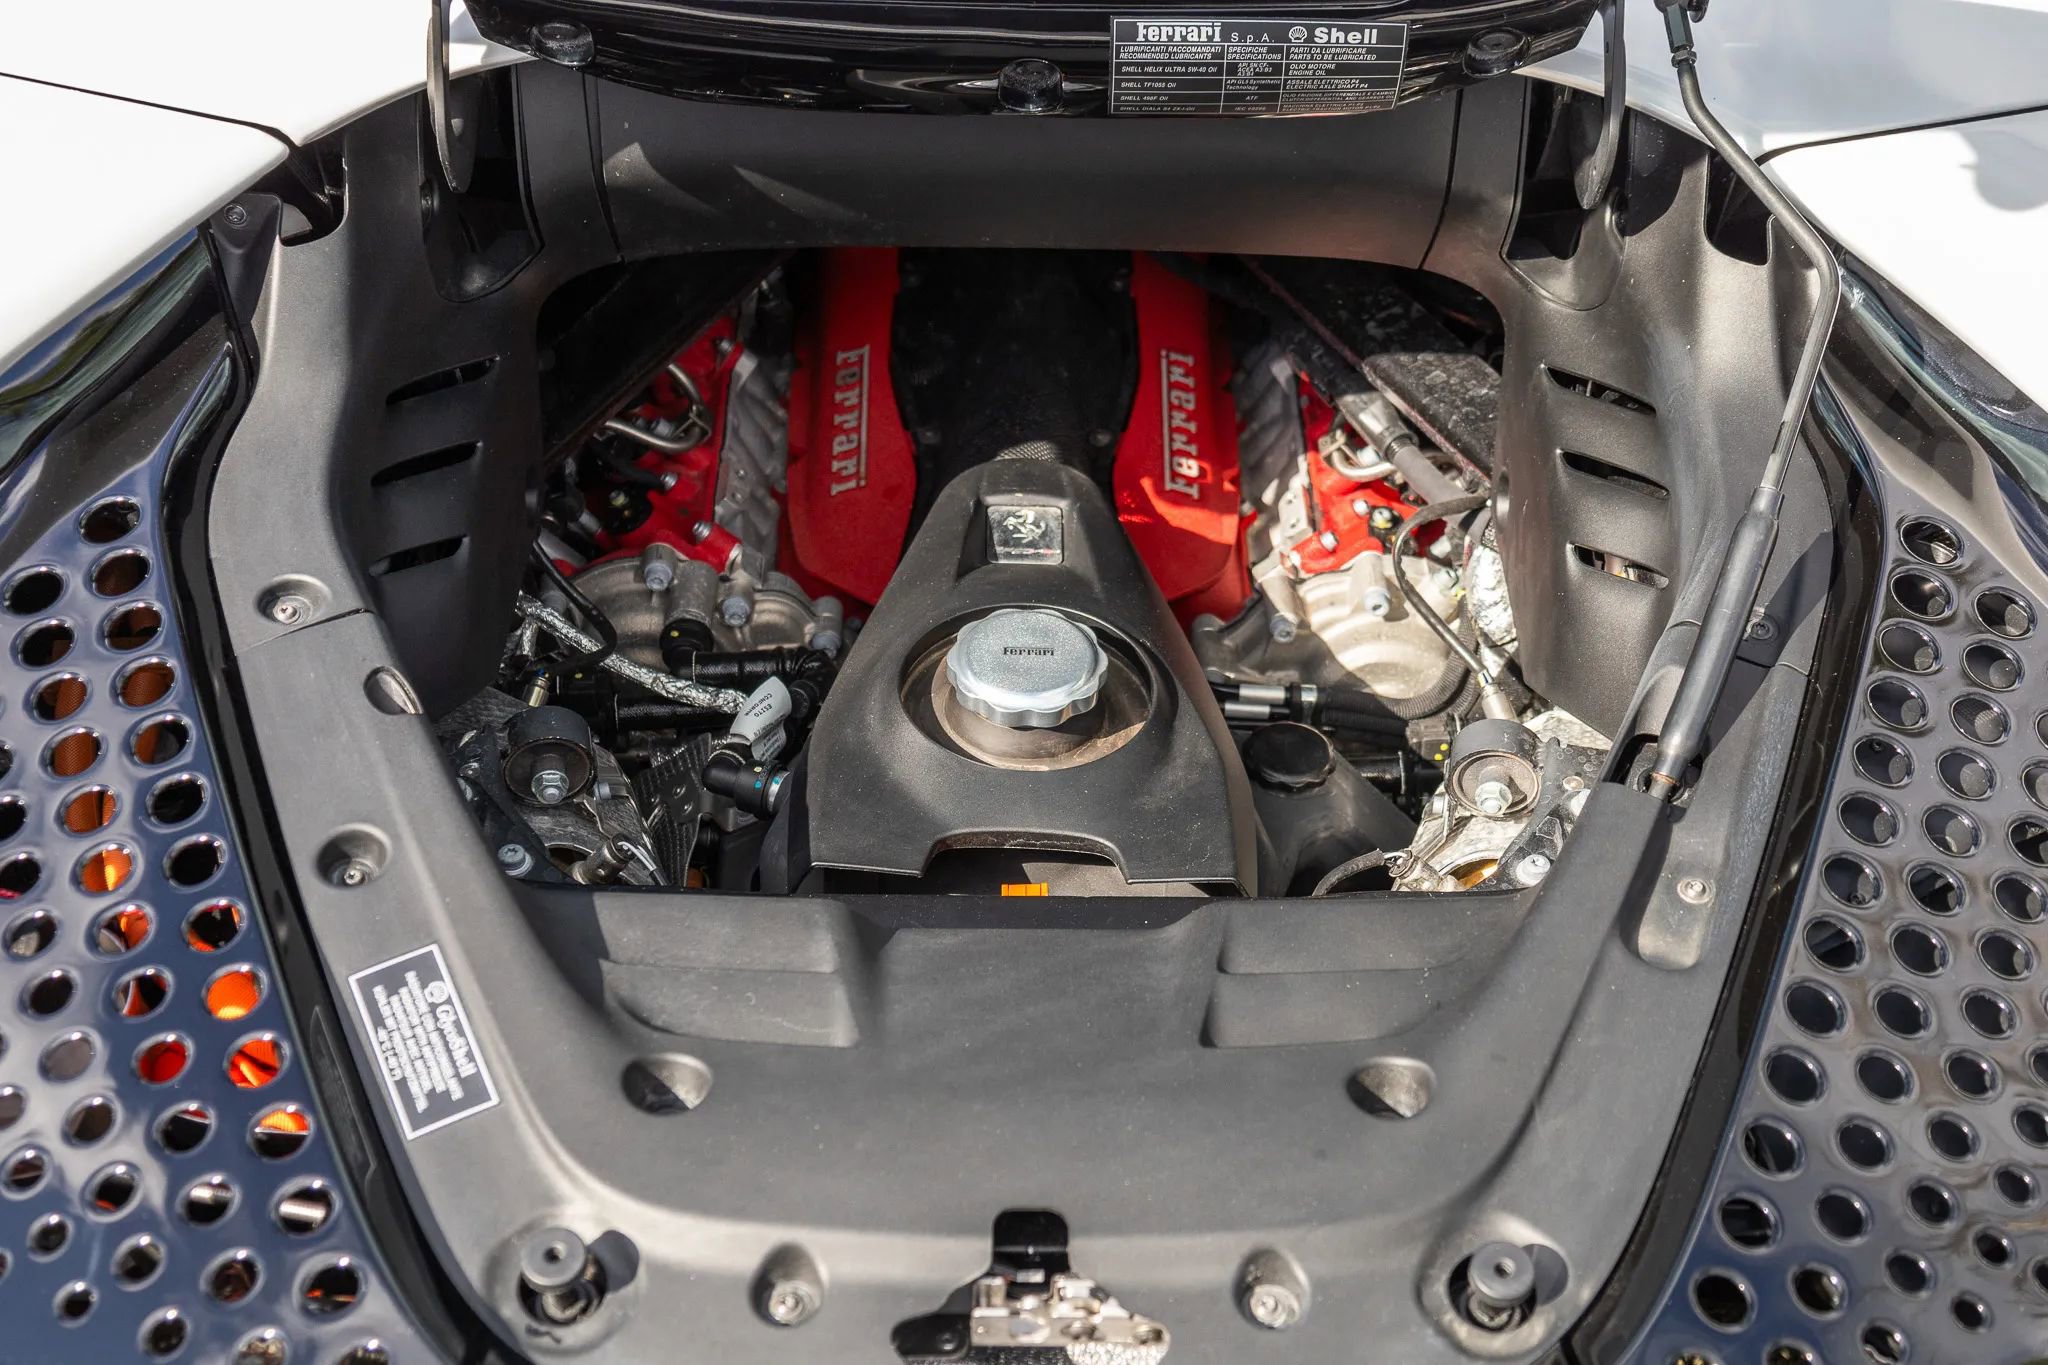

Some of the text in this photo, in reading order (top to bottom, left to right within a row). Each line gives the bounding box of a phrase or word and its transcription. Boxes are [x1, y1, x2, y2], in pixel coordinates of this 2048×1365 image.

[1136, 22, 1221, 42] Ferrari
[1314, 27, 1378, 44] Shell
[830, 343, 870, 496] Ferrari
[1160, 349, 1199, 499] Ferrari
[1003, 646, 1055, 656] Ferrari
